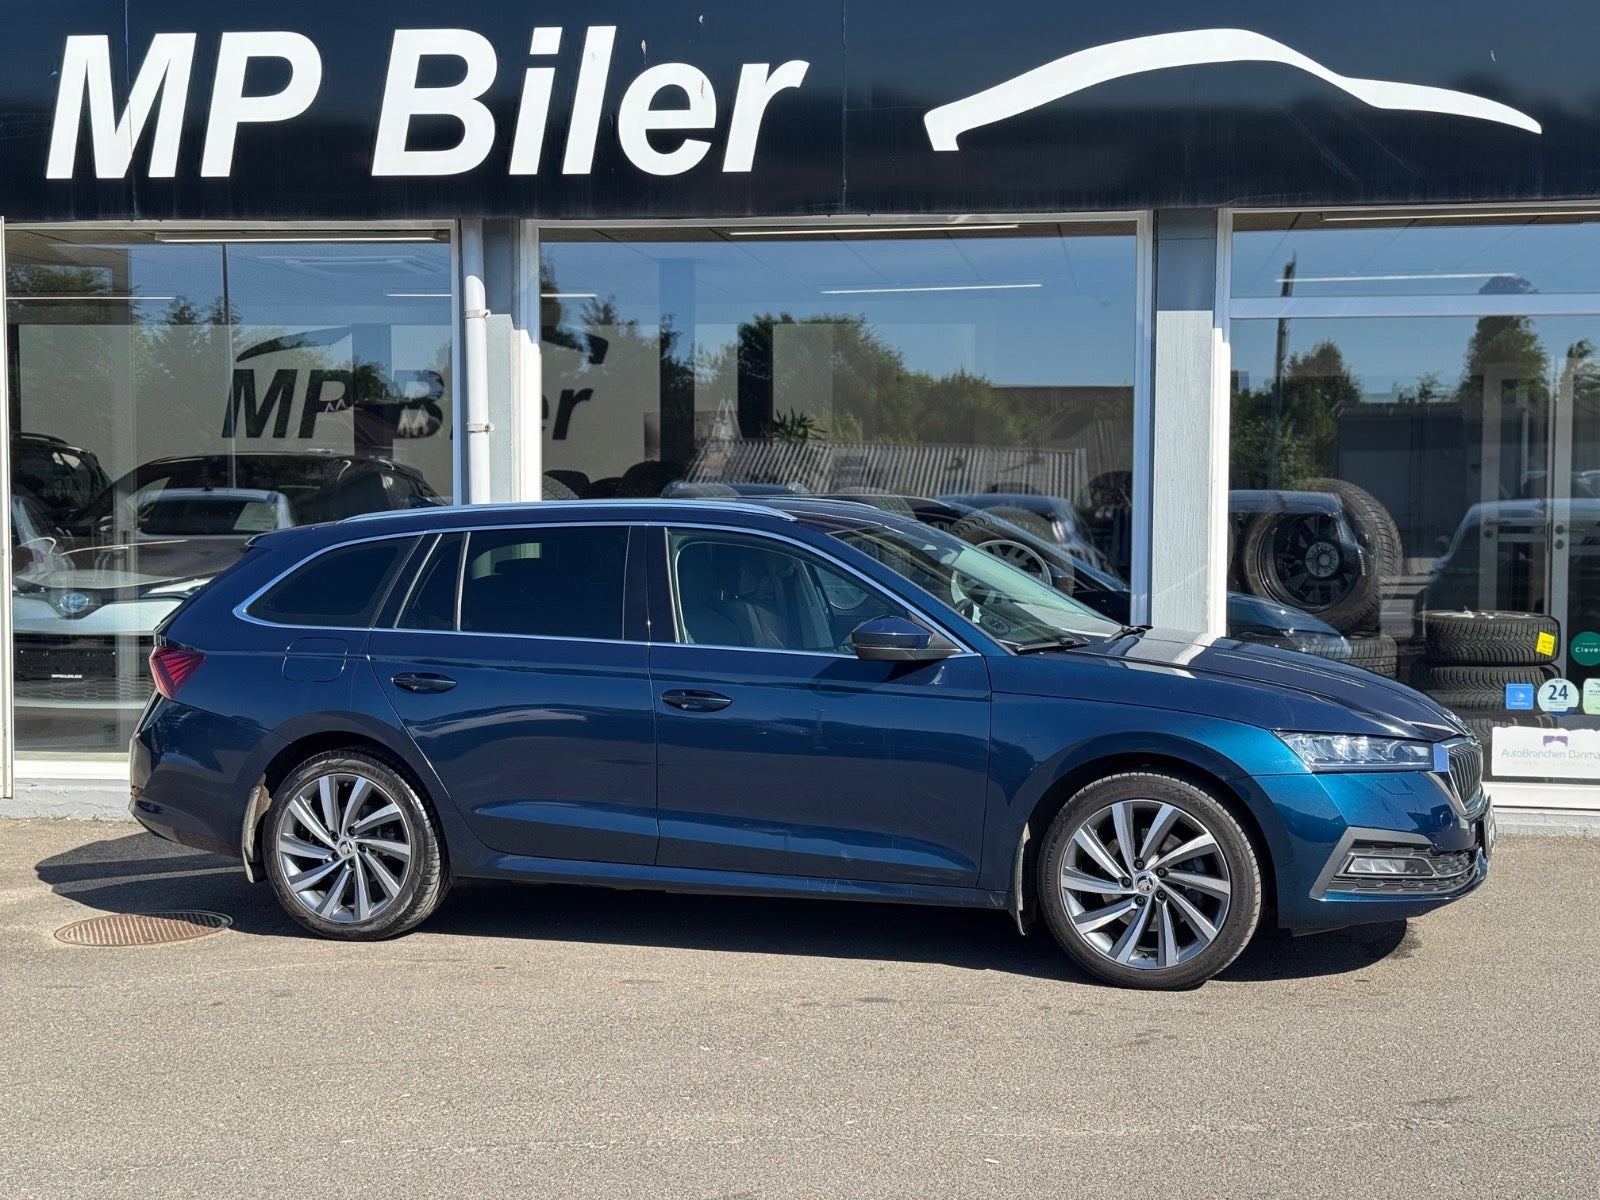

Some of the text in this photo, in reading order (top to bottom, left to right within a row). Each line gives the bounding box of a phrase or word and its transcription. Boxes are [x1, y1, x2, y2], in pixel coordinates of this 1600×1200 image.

[45, 26, 809, 180] MP Biler
[221, 368, 353, 439] MP
[1548, 684, 1569, 701] 24
[1501, 748, 1566, 759] AutoBranchen
